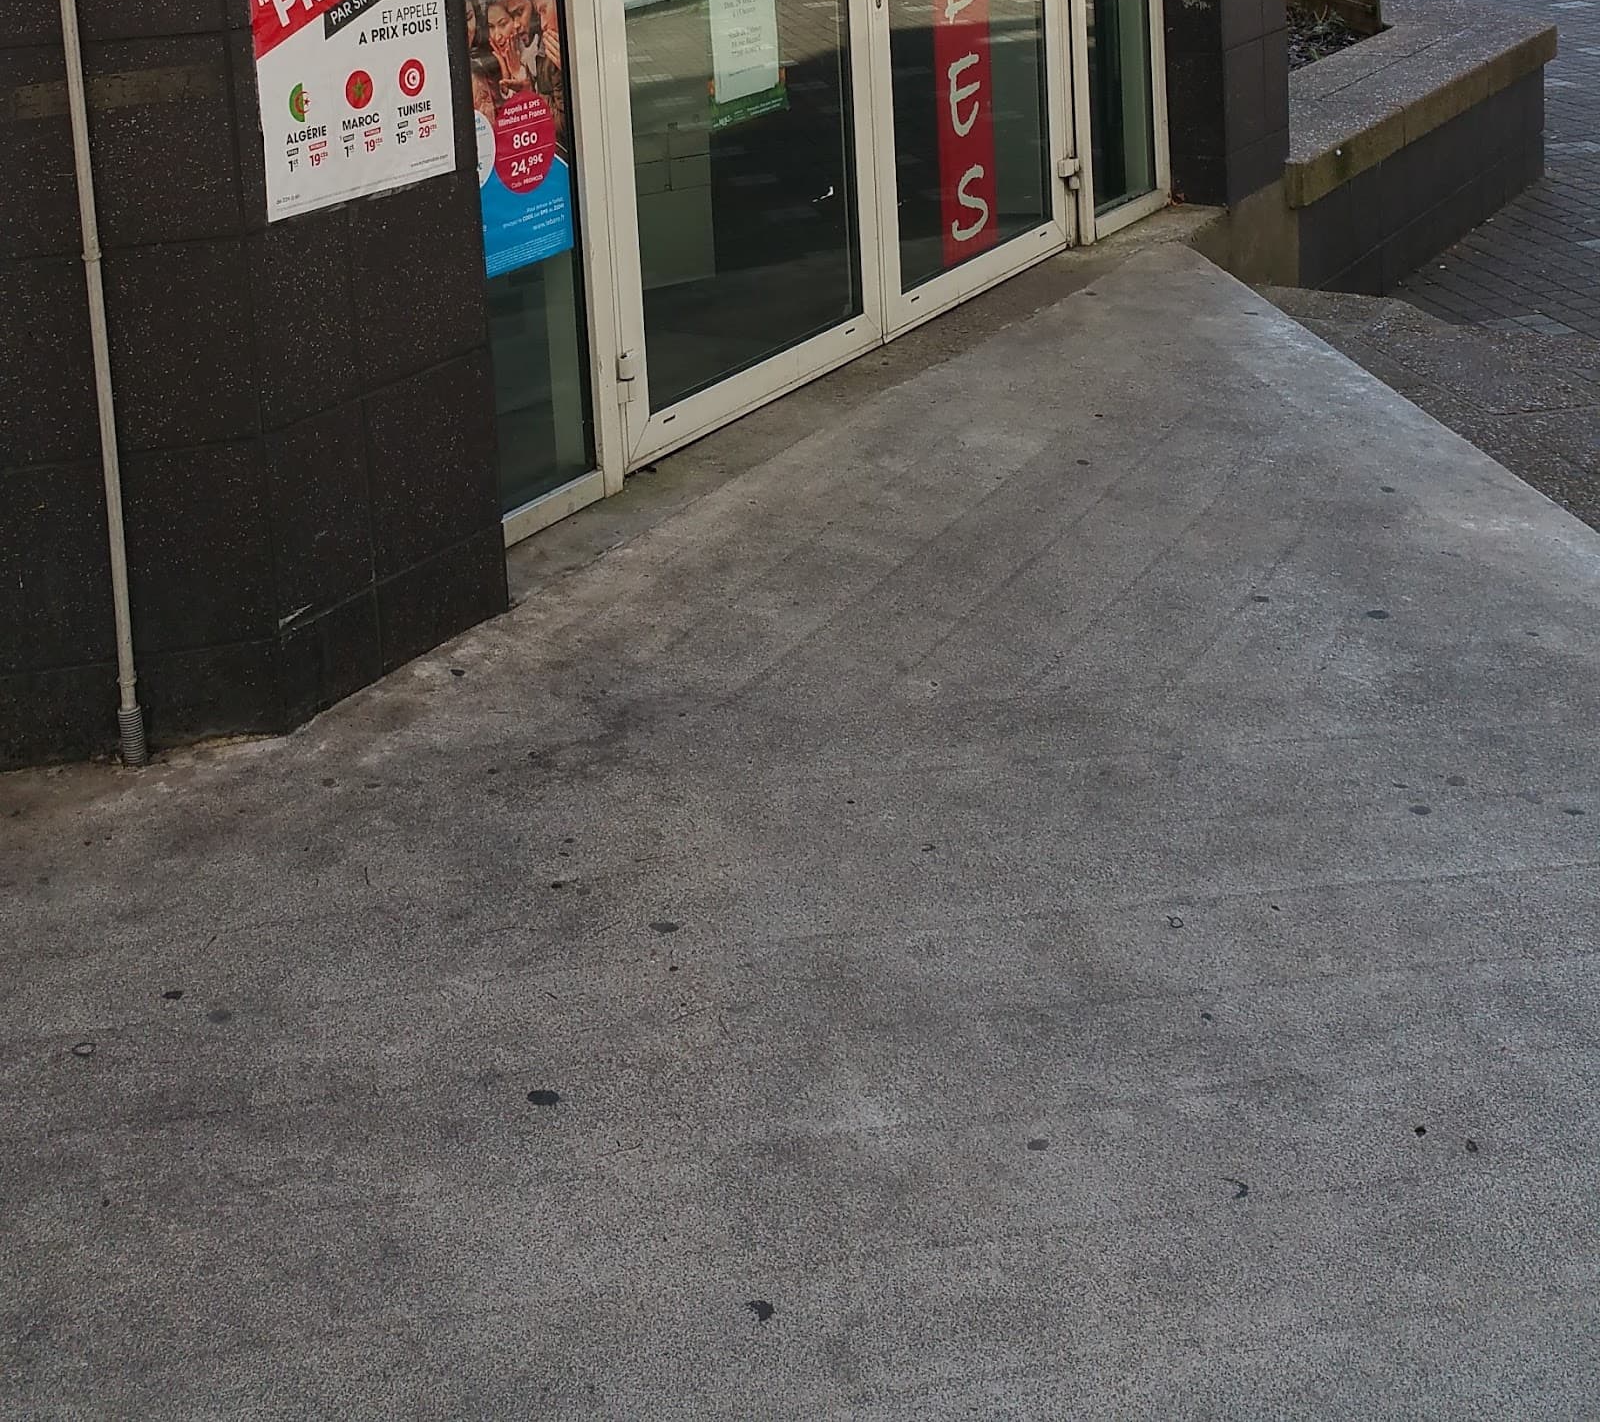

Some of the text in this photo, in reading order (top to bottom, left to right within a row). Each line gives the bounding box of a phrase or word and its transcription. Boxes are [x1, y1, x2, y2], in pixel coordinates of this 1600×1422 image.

[330, 2, 352, 25] PAR
[382, 2, 438, 24] ET APPELEZ
[358, 32, 368, 45] A
[371, 25, 399, 43] PRIX
[397, 100, 431, 118] TUNISIE
[504, 104, 522, 116] Appels
[528, 99, 540, 110] SMS
[521, 113, 528, 121] en
[529, 109, 546, 120] France
[342, 113, 380, 131] MAROC
[286, 125, 327, 145] ALGÉRIE
[513, 131, 537, 149] 8Go
